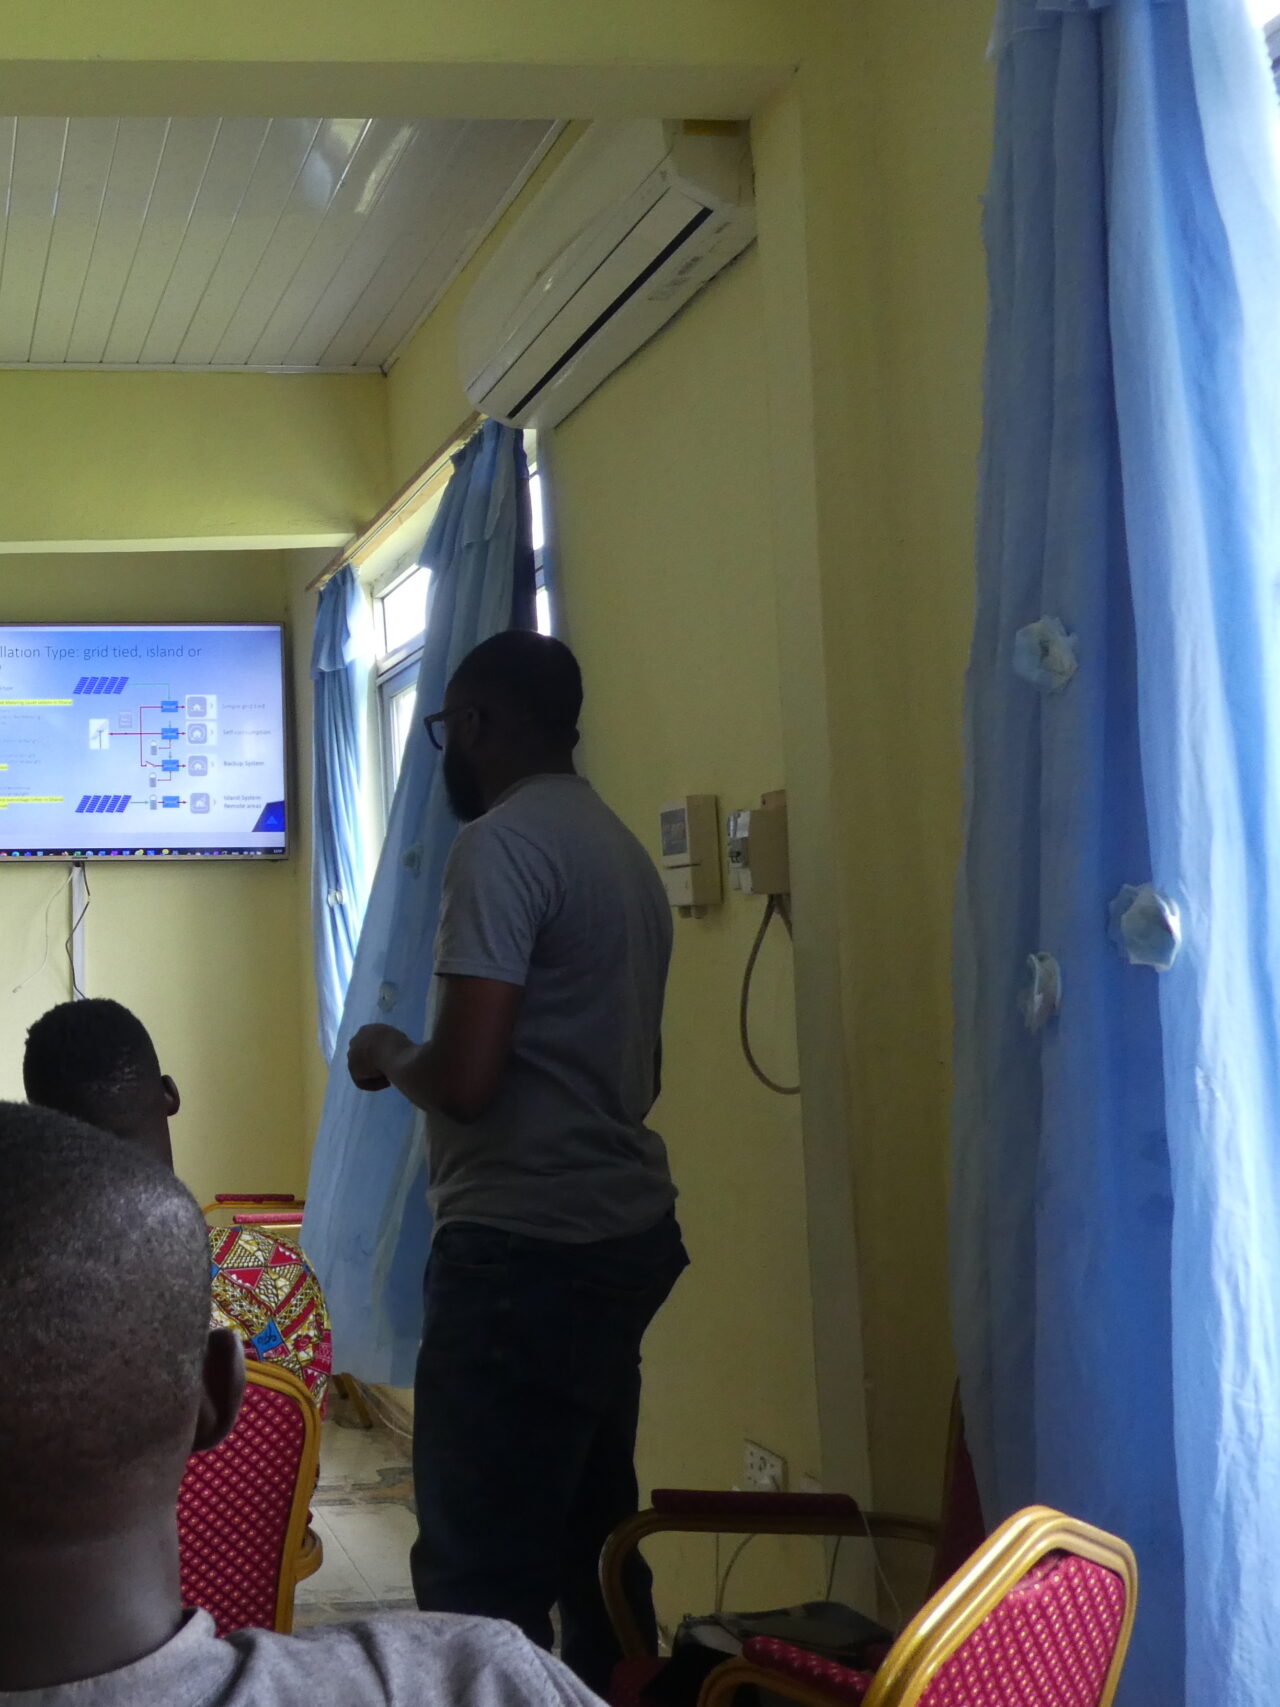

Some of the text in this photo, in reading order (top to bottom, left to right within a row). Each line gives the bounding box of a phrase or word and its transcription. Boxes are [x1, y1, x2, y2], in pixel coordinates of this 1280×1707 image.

[44, 645, 80, 661] Type:
[83, 645, 109, 661] grid
[113, 645, 142, 659] tied,
[146, 645, 184, 658] island
[188, 647, 202, 658] or
